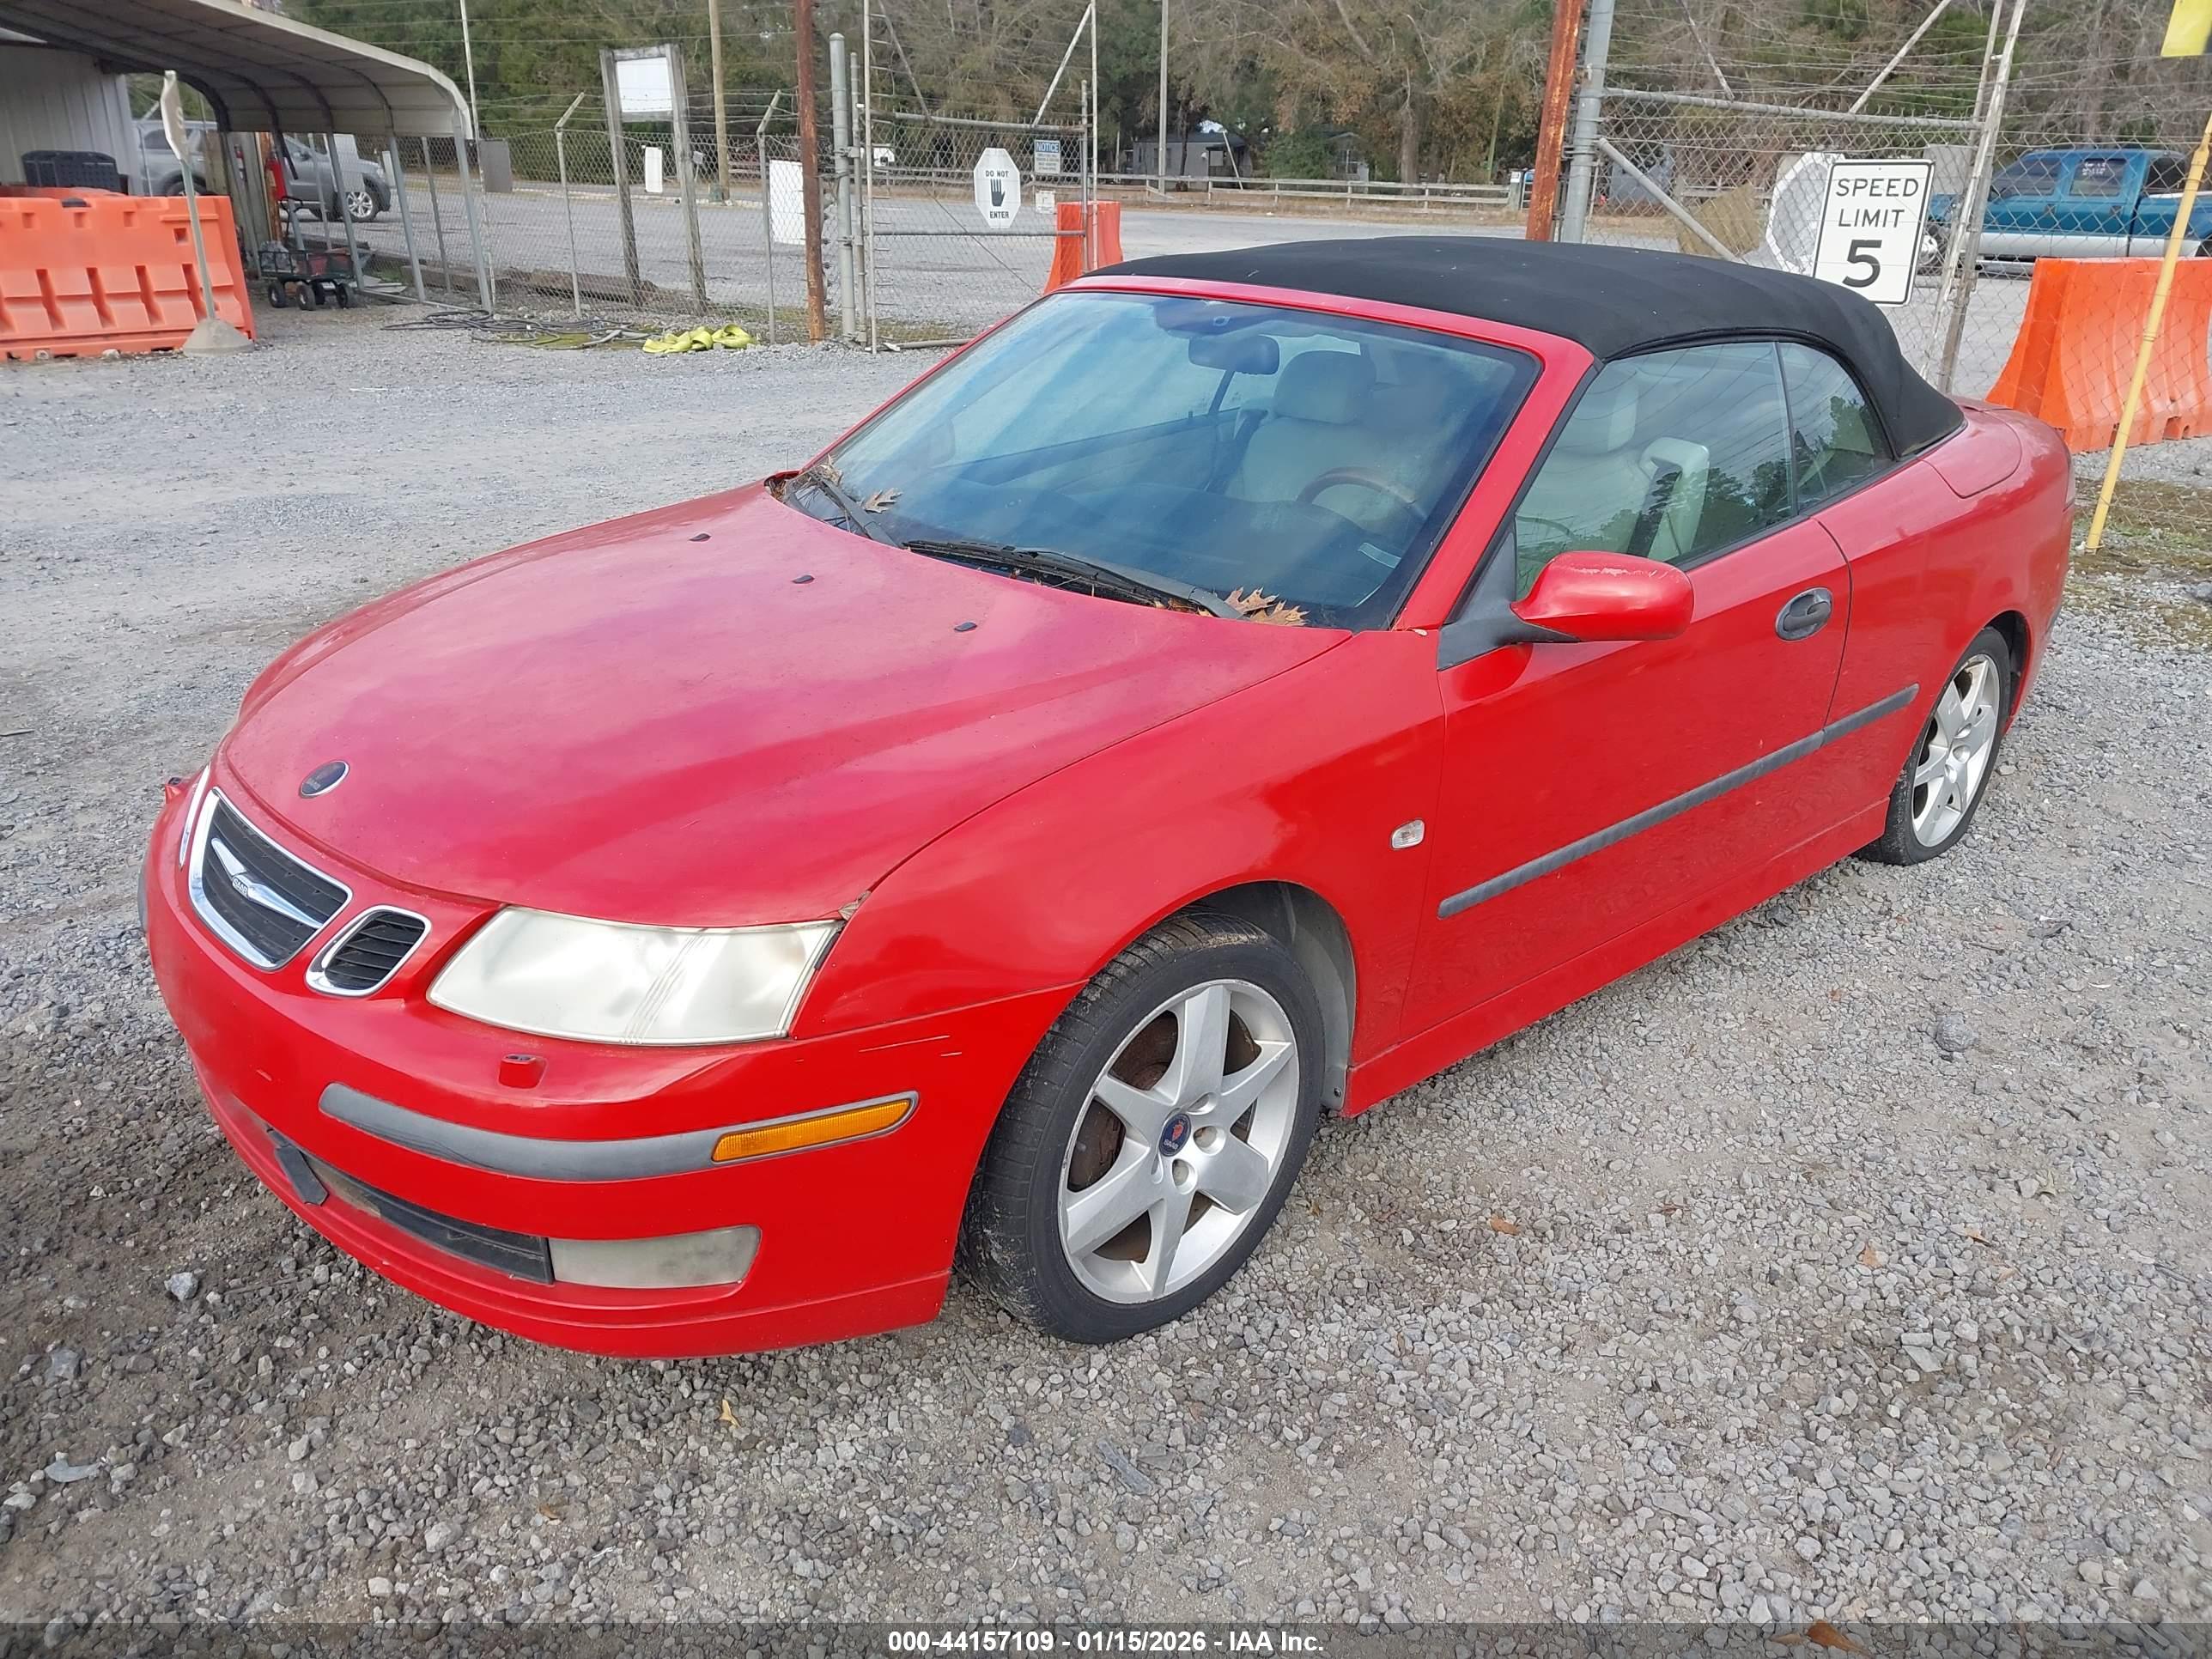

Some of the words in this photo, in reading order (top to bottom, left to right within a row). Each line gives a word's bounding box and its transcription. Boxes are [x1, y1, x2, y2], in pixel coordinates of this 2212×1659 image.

[1036, 142, 1059, 152] NOTICE
[1835, 178, 1919, 198] SPEED
[989, 210, 1009, 219] ENTER
[1838, 208, 1905, 228] LIMIT
[1842, 239, 1883, 288] 5
[233, 877, 248, 896] SAAB
